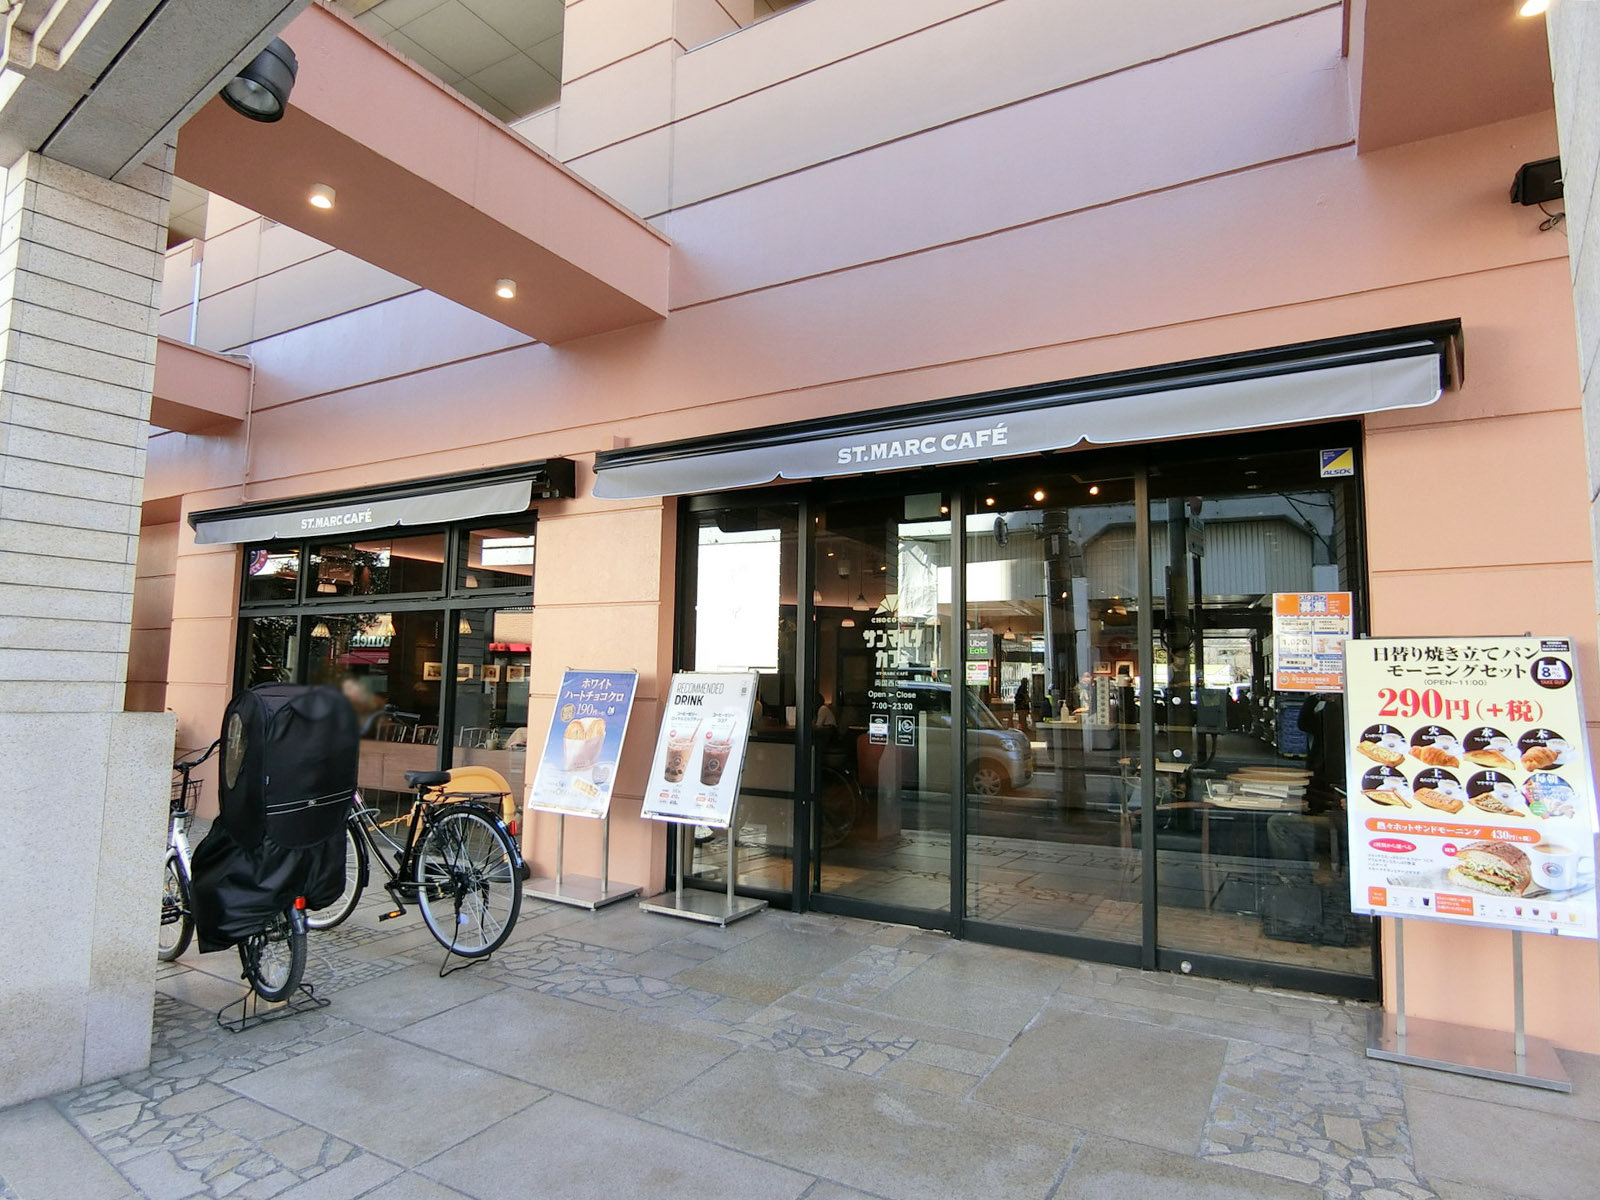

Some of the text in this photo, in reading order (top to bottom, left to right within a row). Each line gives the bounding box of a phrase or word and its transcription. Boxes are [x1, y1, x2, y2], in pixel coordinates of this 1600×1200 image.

[837, 422, 1008, 464] ST.MARC CAFÉ
[301, 508, 373, 529] ST.MARC CAFÉ
[862, 629, 923, 648] サンマルク
[969, 639, 988, 647] Uber
[1373, 645, 1540, 662] 日替り焼き立てパン
[1386, 664, 1527, 679] モーニングセット
[581, 678, 612, 690] ホワイト
[676, 682, 725, 694] RECOMMENDED
[564, 689, 625, 702] ハートチョコクロ
[674, 694, 705, 706] DRINK
[867, 690, 917, 699] Open Close
[1378, 725, 1388, 734] 月
[1428, 726, 1440, 736] 火
[1481, 727, 1493, 737] 水
[1536, 729, 1548, 739] 木
[1431, 768, 1443, 778] 土
[1485, 771, 1496, 781] 日
